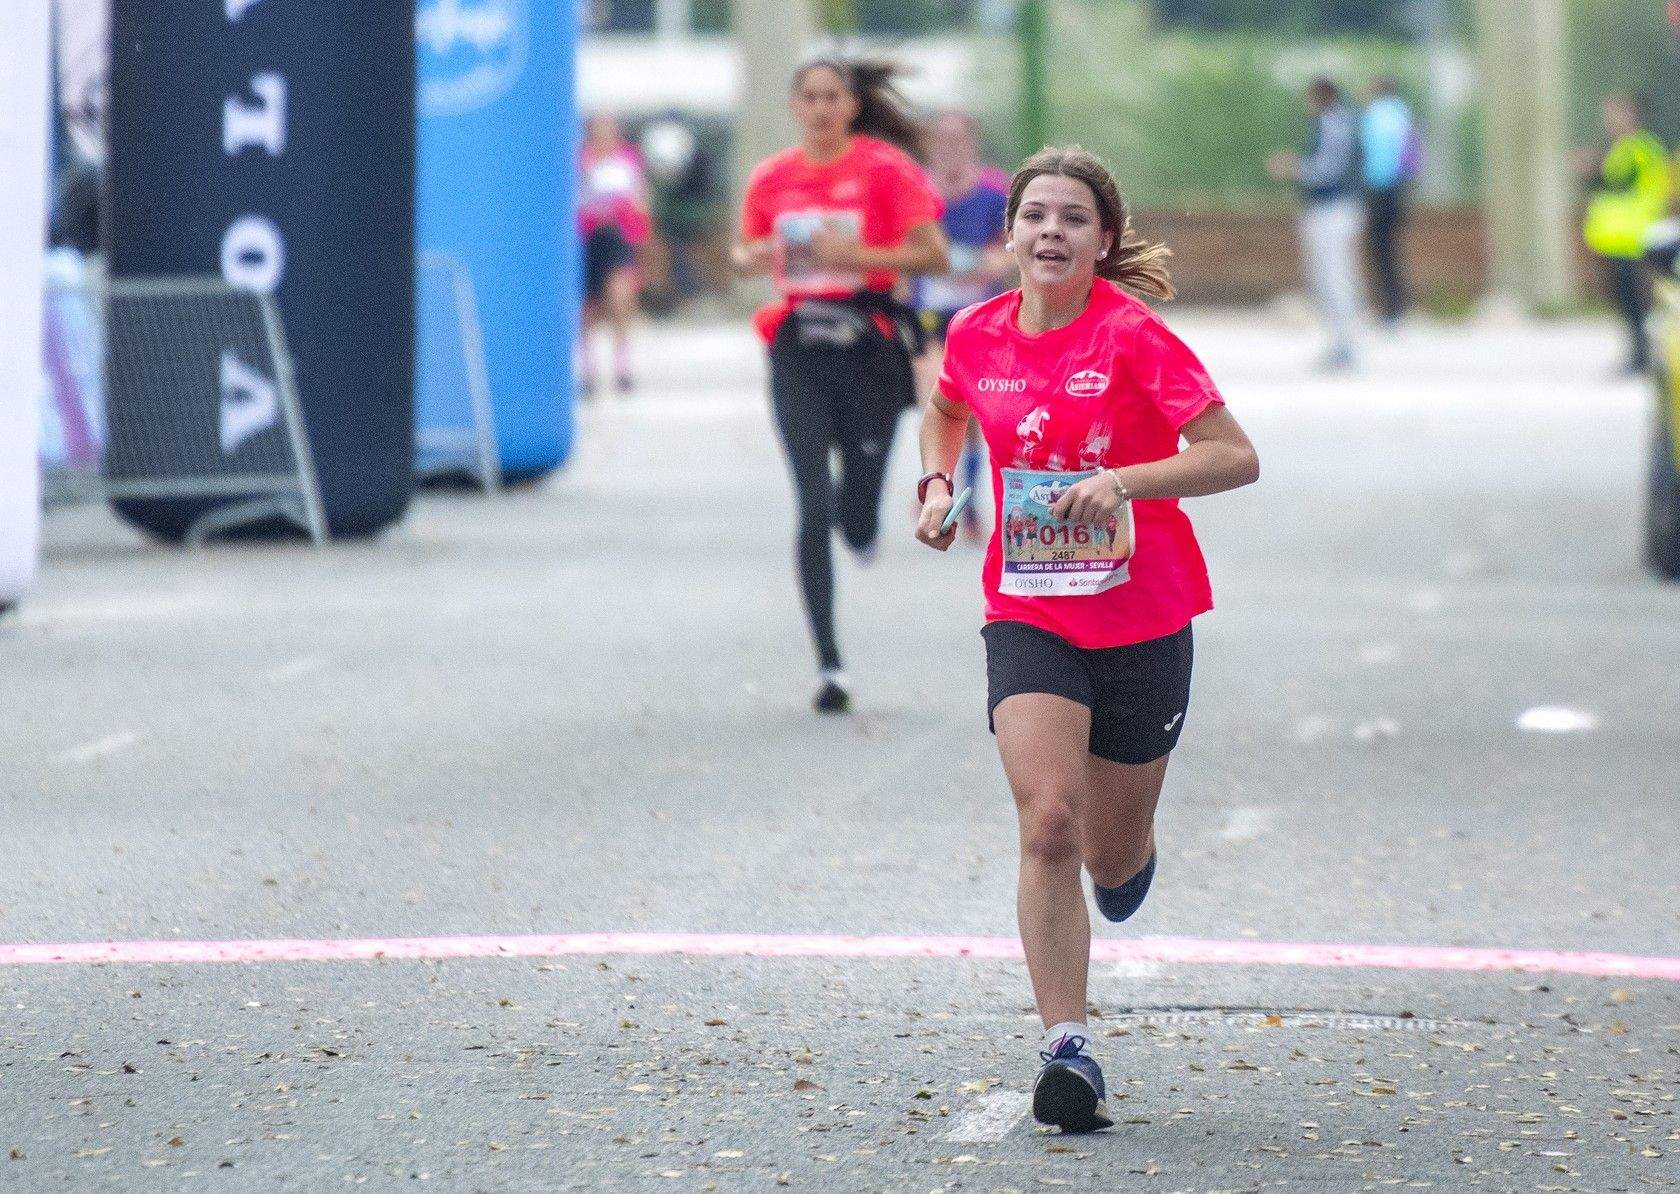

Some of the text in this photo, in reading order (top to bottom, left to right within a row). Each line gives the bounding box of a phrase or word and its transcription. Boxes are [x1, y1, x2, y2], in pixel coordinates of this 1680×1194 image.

[977, 377, 1027, 393] OYSHO
[1039, 524, 1091, 546] 016
[1051, 551, 1075, 560] 2487
[1016, 563, 1043, 571] CARRERA
[1089, 561, 1113, 569] SEVILLA
[1014, 578, 1053, 589] OYSHO
